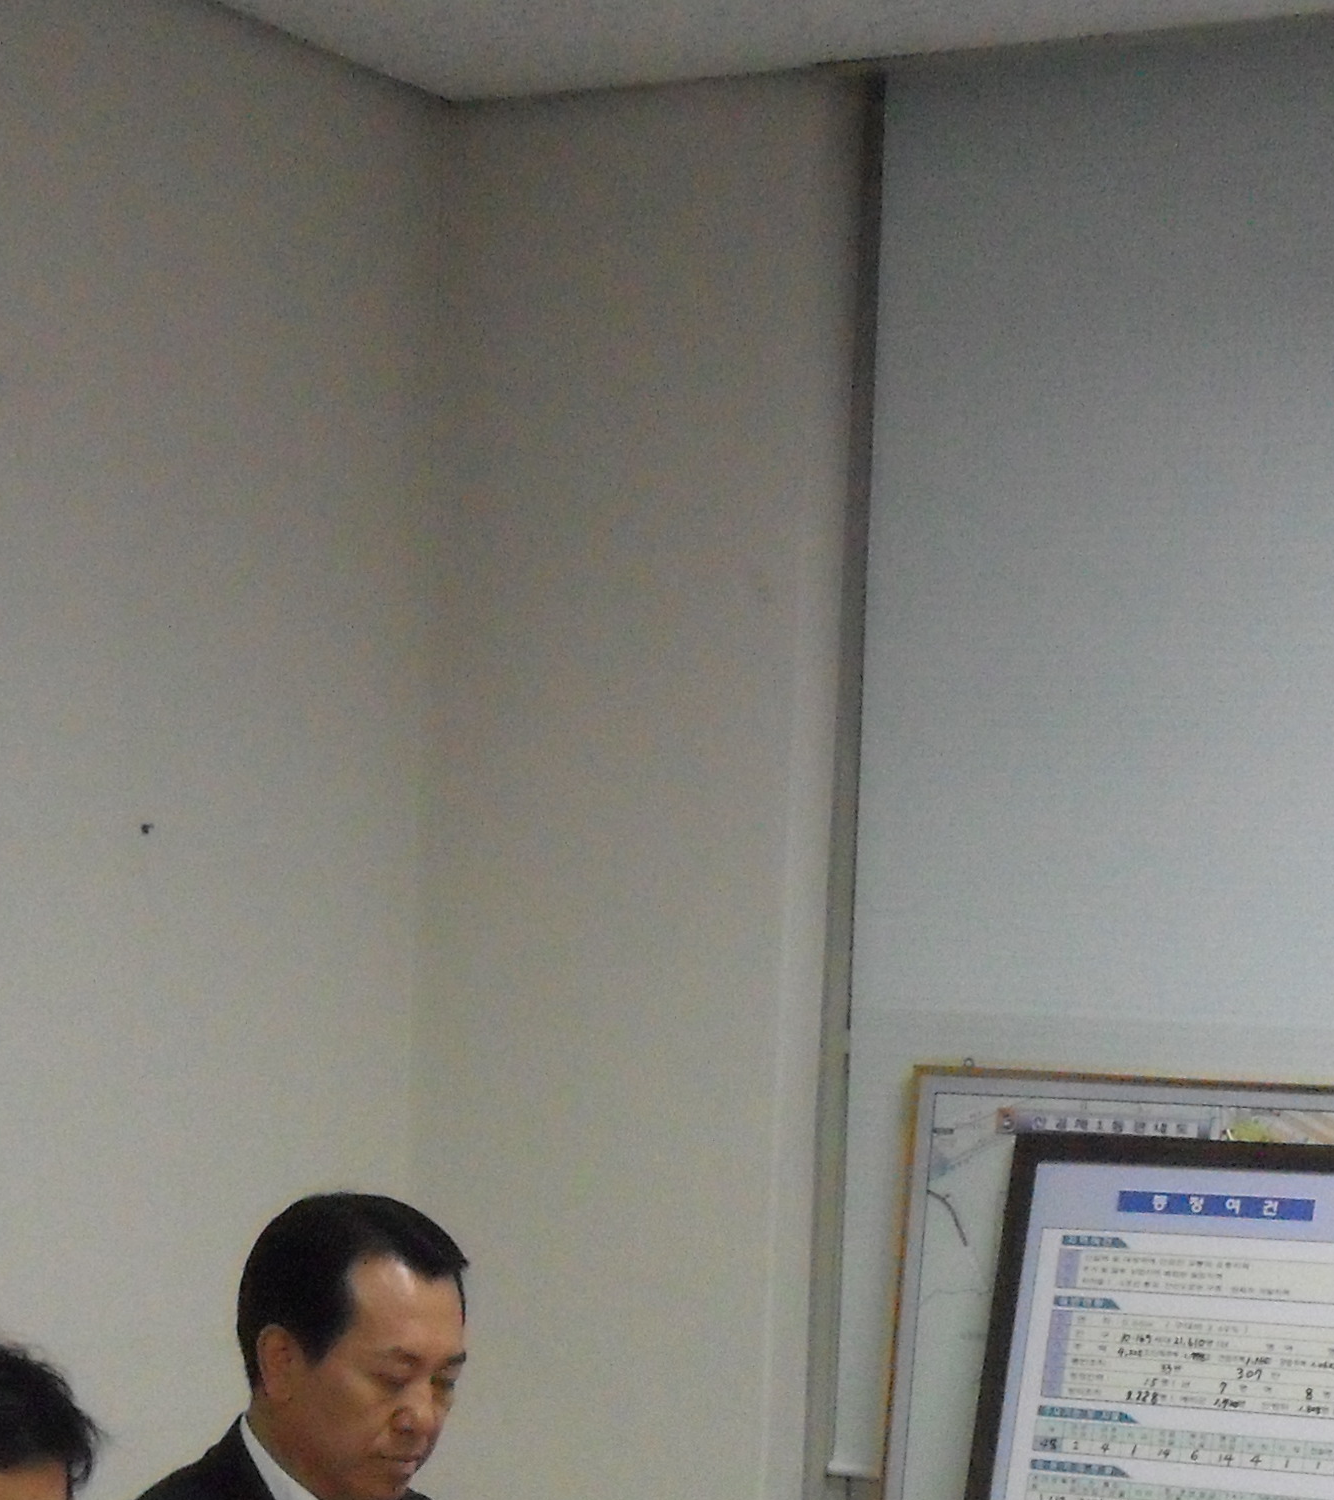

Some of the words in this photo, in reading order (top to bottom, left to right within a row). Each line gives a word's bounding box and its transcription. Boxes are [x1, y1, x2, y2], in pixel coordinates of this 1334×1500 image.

[1153, 1193, 1279, 1217] 동정여건
[1236, 1367, 1263, 1381] 307
[1250, 1454, 1262, 1466] 4
